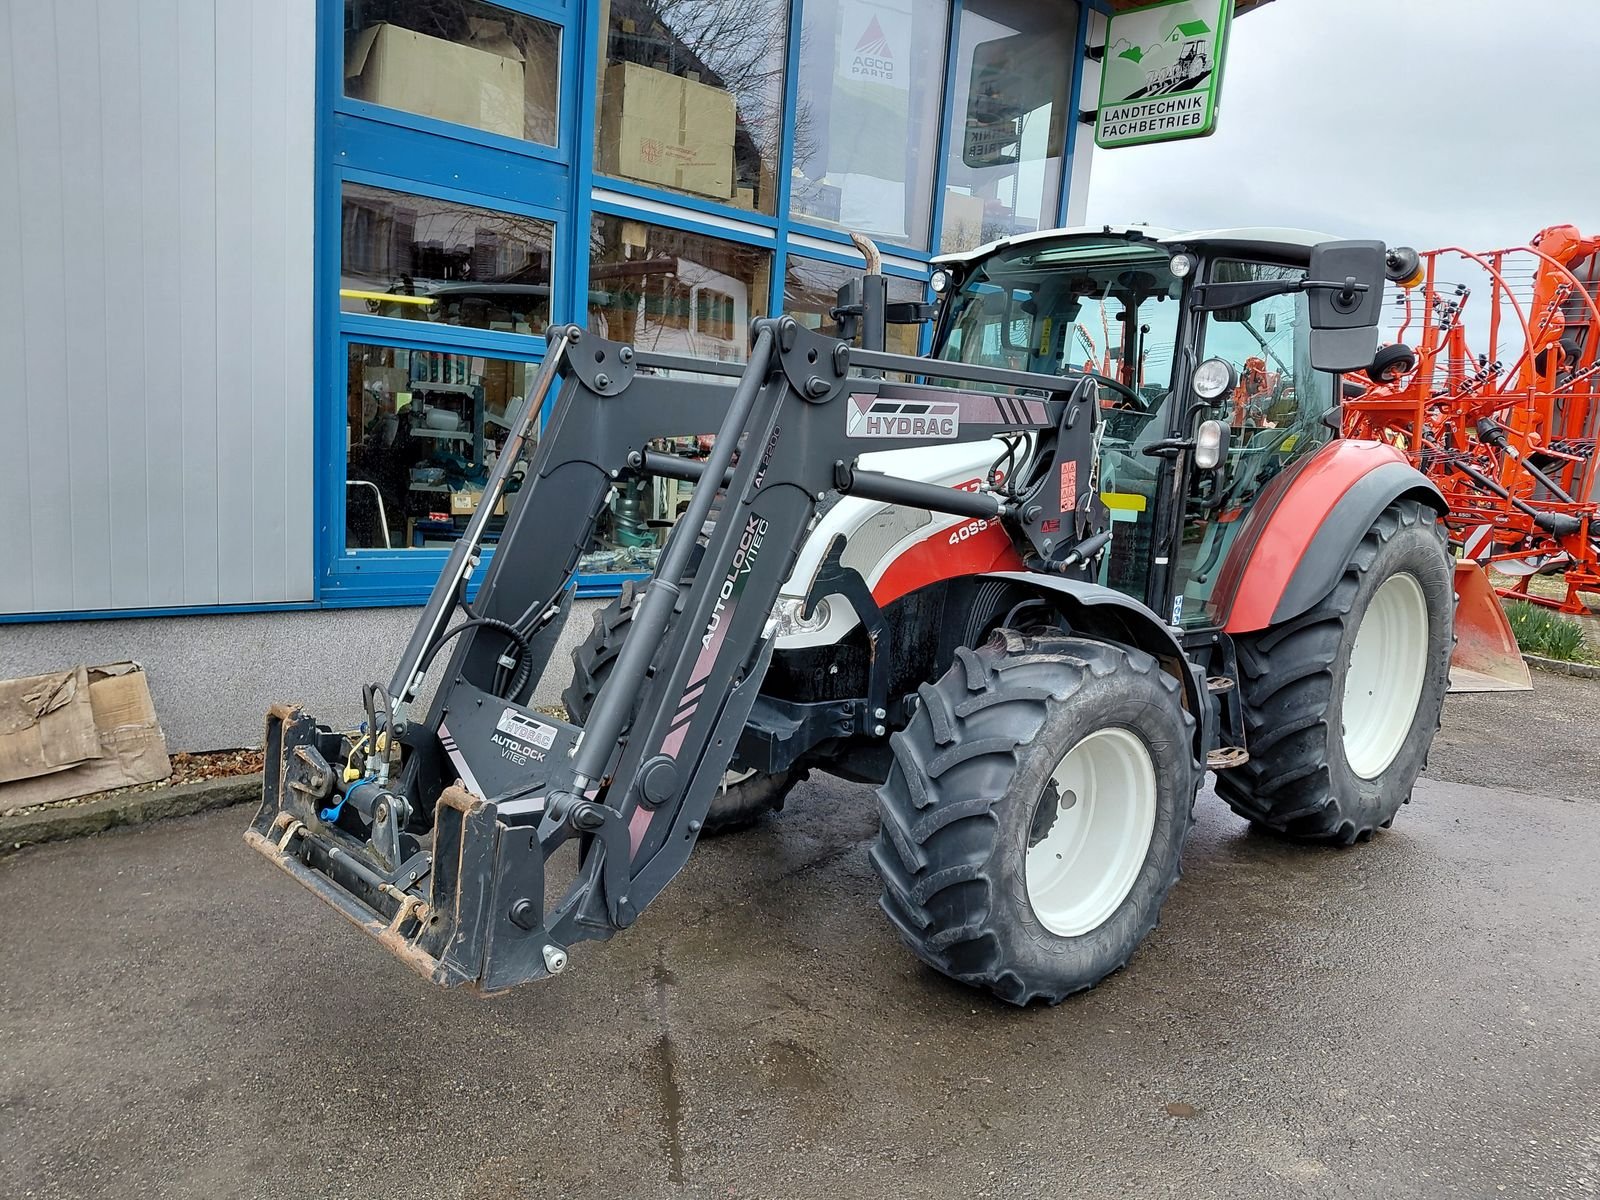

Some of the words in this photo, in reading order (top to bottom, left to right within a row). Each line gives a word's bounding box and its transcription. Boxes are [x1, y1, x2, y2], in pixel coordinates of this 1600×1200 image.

[851, 66, 893, 80] PARTS
[852, 56, 894, 72] AGCO
[1104, 96, 1202, 122] LANDTECHNIK
[1102, 112, 1201, 137] FACHBETRIEB
[866, 416, 953, 436] HYDRAC
[755, 469, 766, 489] AL
[763, 425, 781, 466] 2200
[701, 514, 760, 651] AUTOLOCK
[505, 721, 552, 747] HYDRAC
[490, 733, 546, 763] AUTOLOCK
